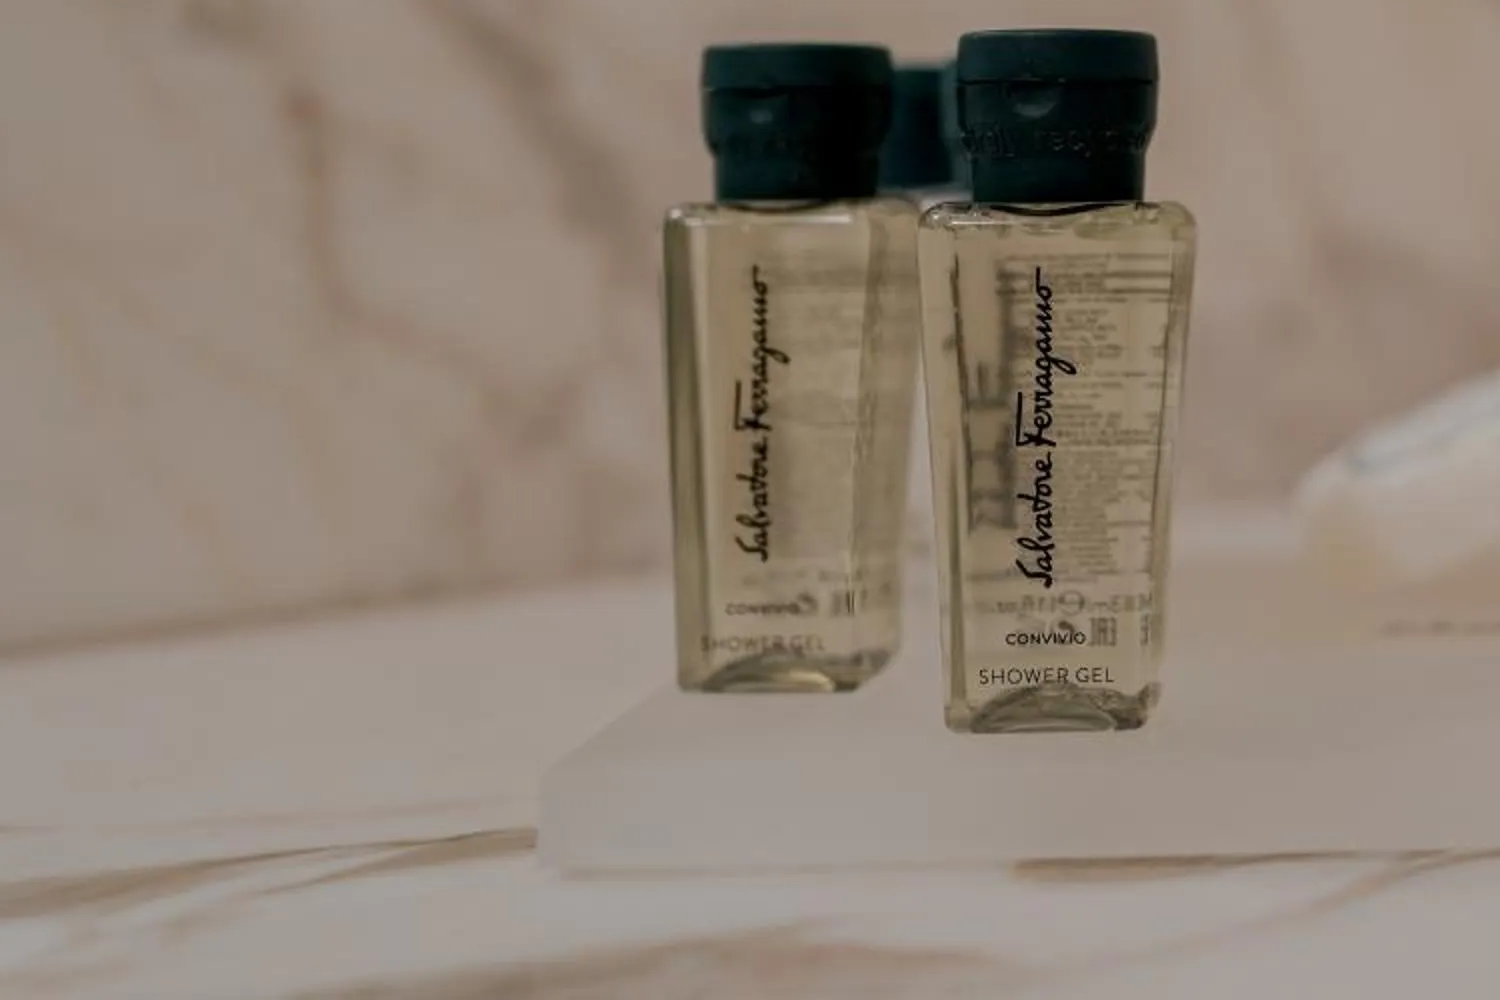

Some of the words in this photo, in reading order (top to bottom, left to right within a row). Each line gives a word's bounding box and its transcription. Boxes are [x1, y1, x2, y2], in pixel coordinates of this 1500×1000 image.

[733, 264, 791, 432] Ferragamo
[1015, 266, 1077, 447] Ferragamo
[735, 436, 773, 563] Salvatore
[1015, 450, 1055, 588] Salvatore
[978, 666, 1069, 685] SHOWER
[1075, 666, 1116, 683] GEL
[1005, 631, 1087, 646] CONVIVIO
